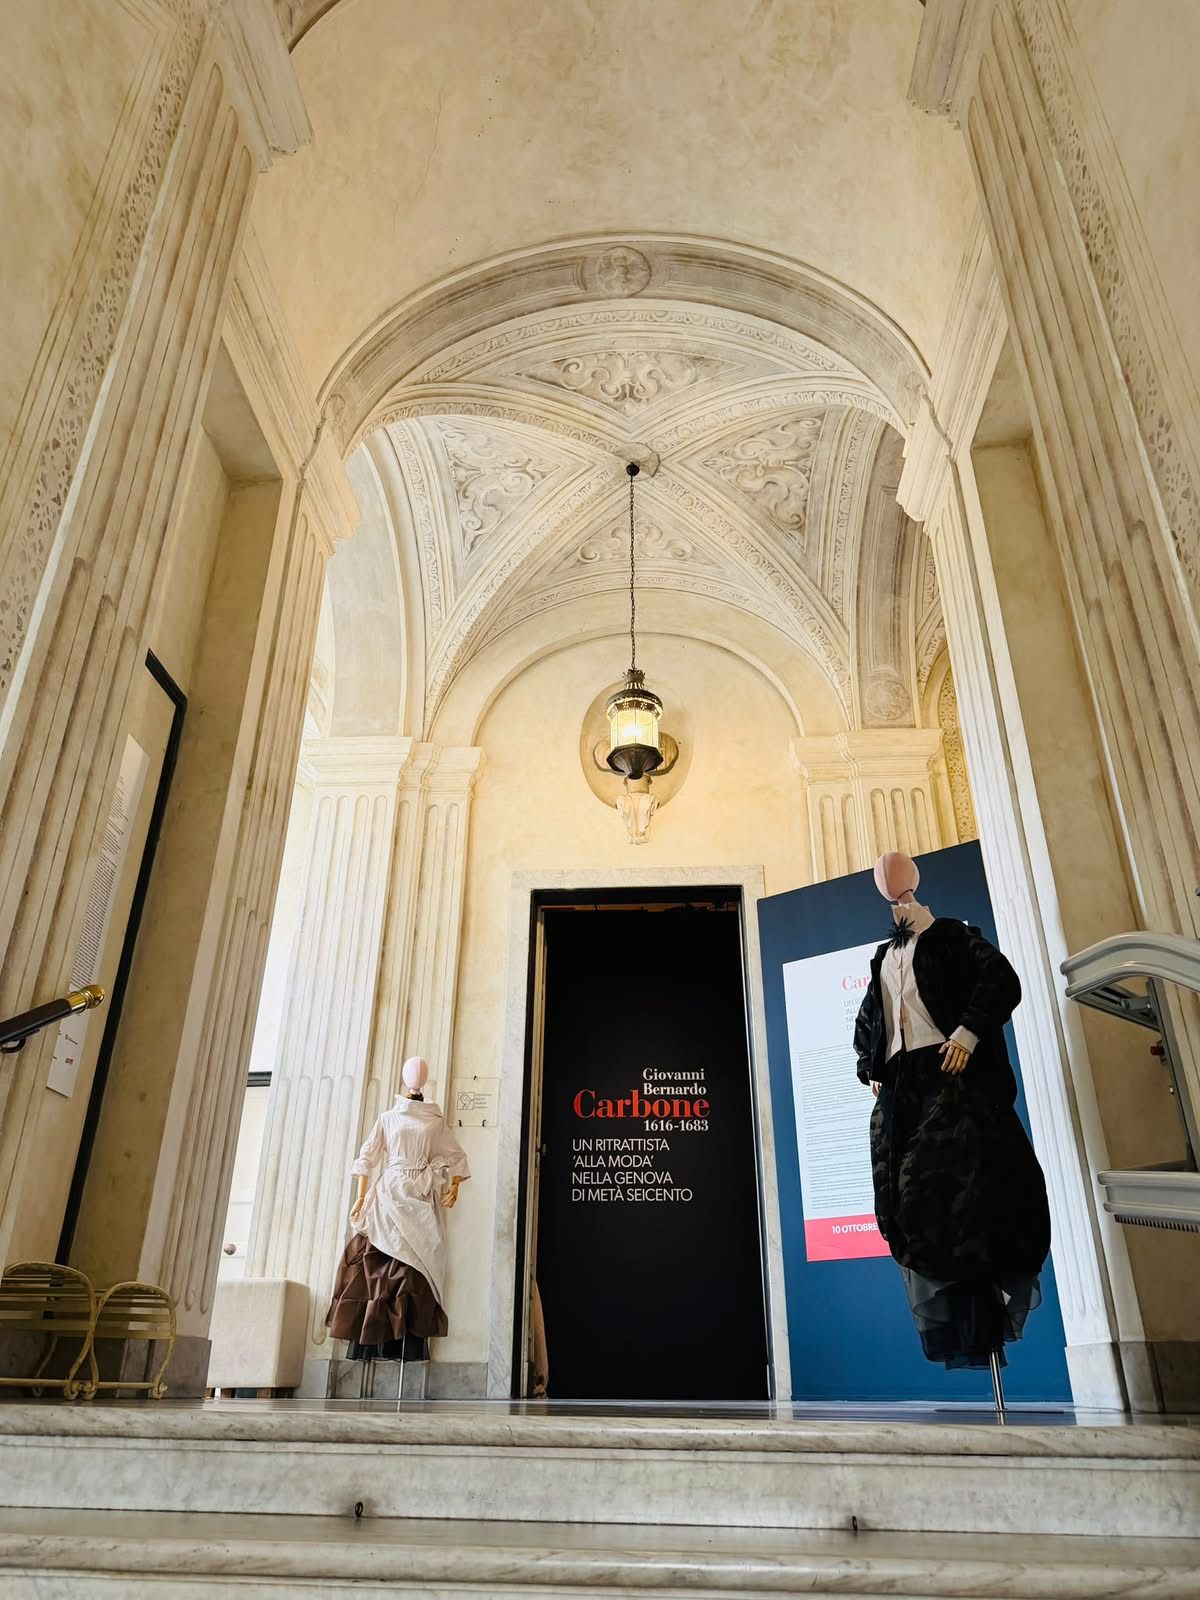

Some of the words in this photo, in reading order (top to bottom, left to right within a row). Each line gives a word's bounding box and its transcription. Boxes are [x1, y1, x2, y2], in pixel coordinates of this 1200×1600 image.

[643, 1067, 705, 1081] Giovanni
[643, 1082, 707, 1096] Bernardo
[573, 1089, 710, 1119] Carbone
[643, 1119, 709, 1132] 1616-1683
[572, 1138, 593, 1151] UN
[595, 1138, 670, 1151] RITRATTISTA
[572, 1155, 606, 1168] 'ALLA
[608, 1155, 654, 1168] MODA'
[572, 1171, 612, 1185] NELLA
[614, 1171, 674, 1185] GENOVA
[572, 1188, 585, 1201] DI
[587, 1185, 625, 1201] METÀ
[626, 1187, 693, 1202] SEICENTO
[832, 1225, 841, 1234] 10
[841, 1222, 879, 1233] OTTOBRE
